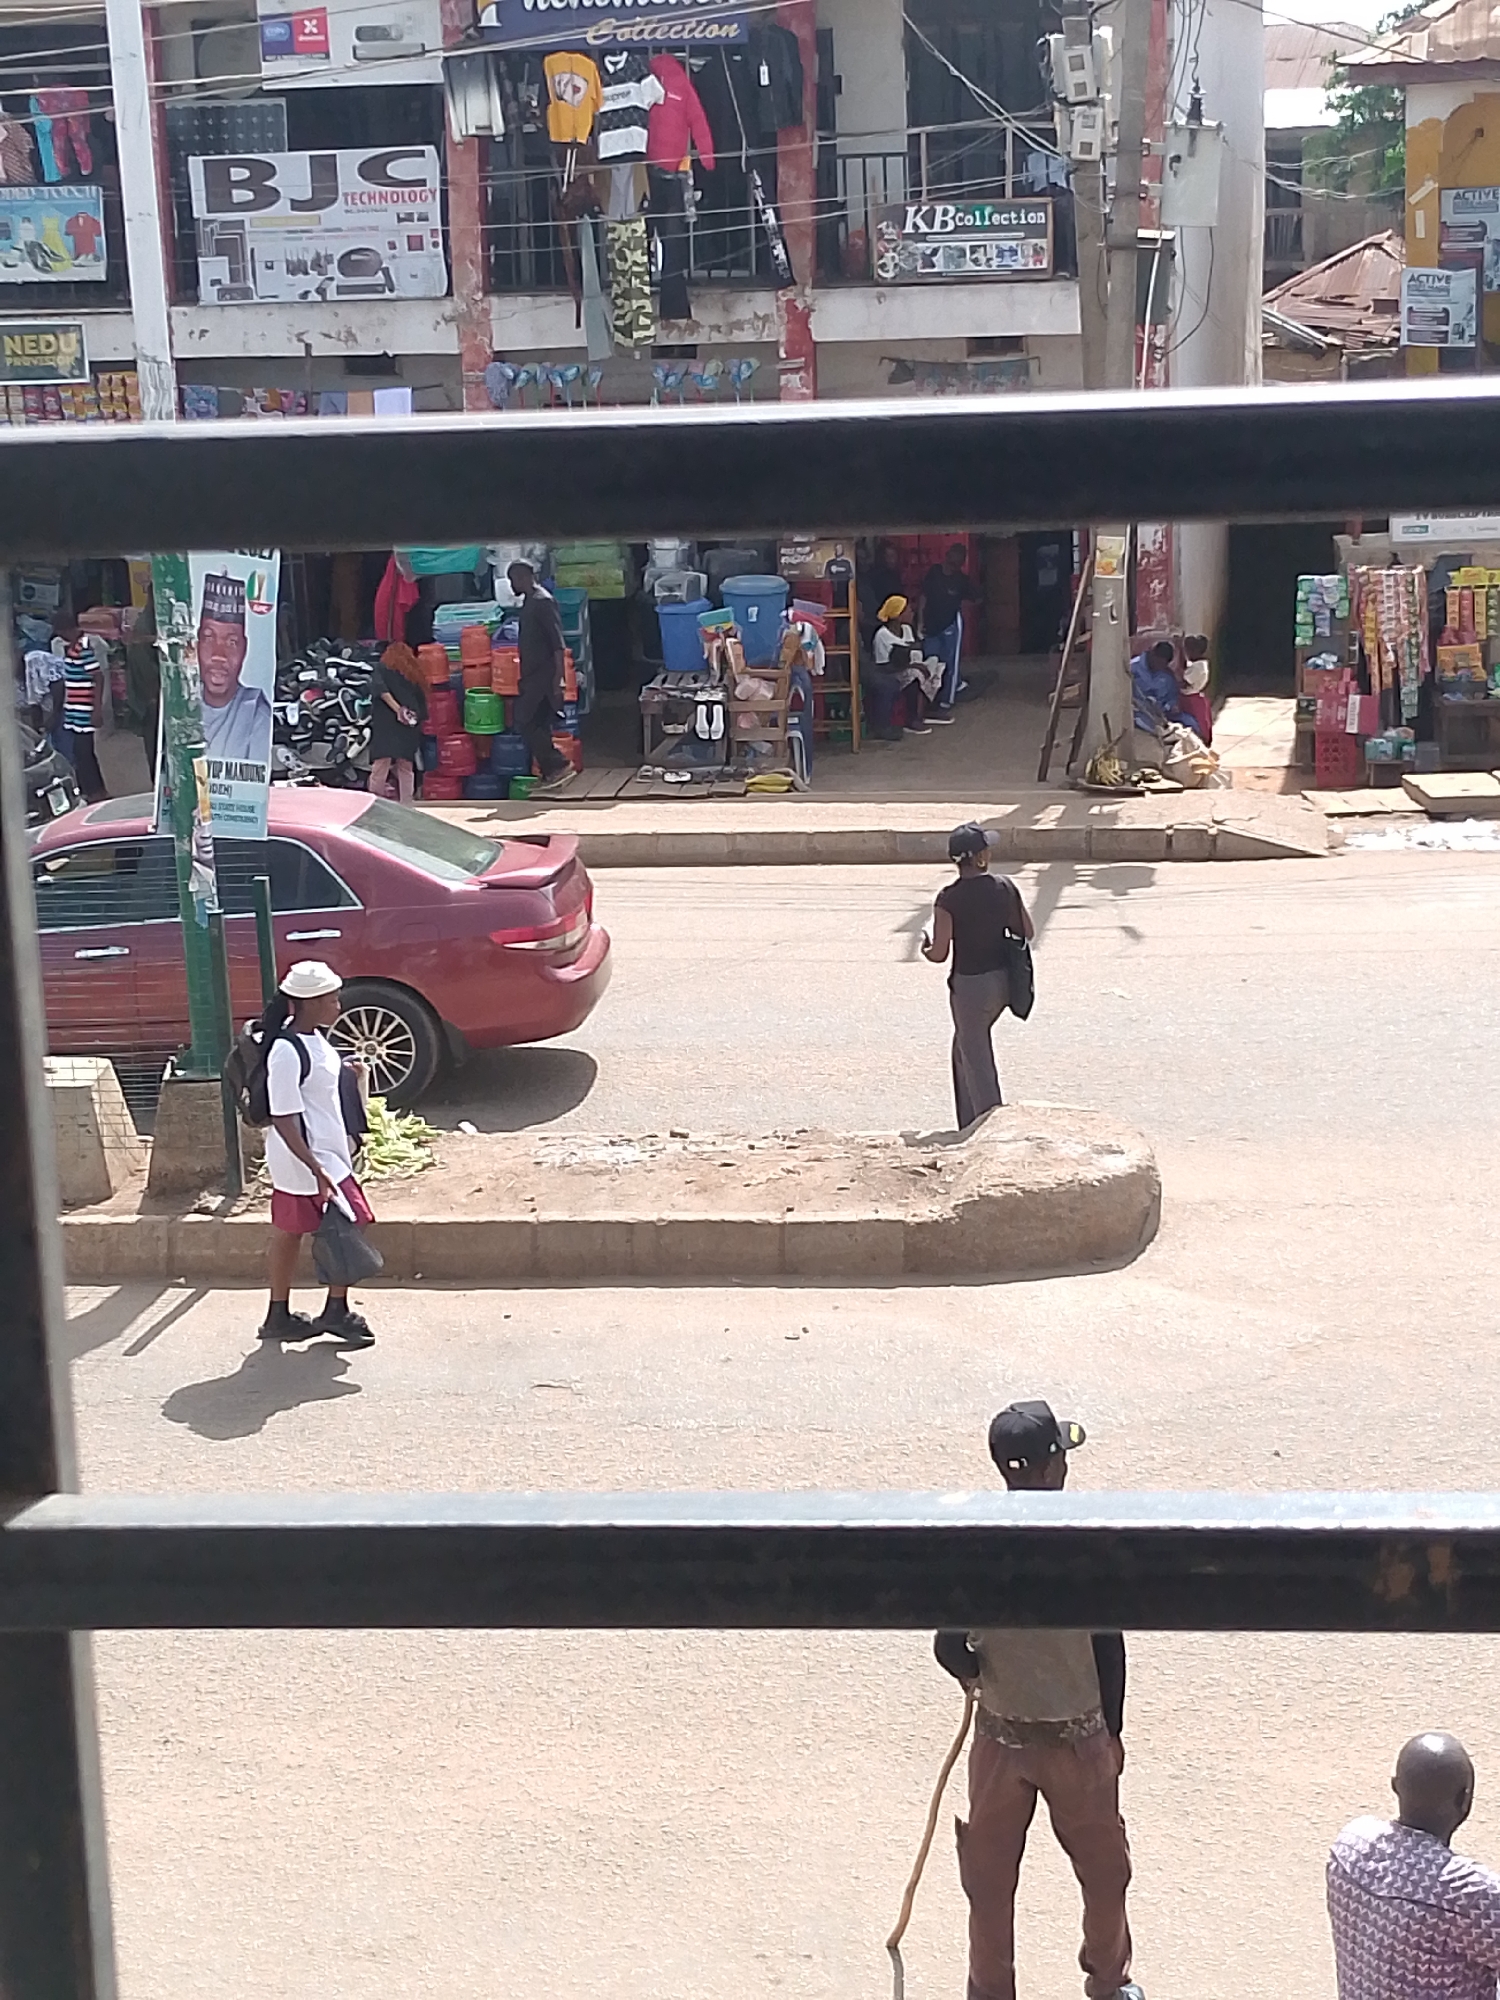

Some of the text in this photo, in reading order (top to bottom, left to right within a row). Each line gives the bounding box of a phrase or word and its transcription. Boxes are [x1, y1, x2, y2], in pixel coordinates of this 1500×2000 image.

[586, 17, 740, 45] Collection
[203, 149, 427, 214] BJC
[342, 188, 437, 206] TECHNOLOGY
[1408, 273, 1452, 285] ACTIVE
[3, 332, 77, 355] NEDU
